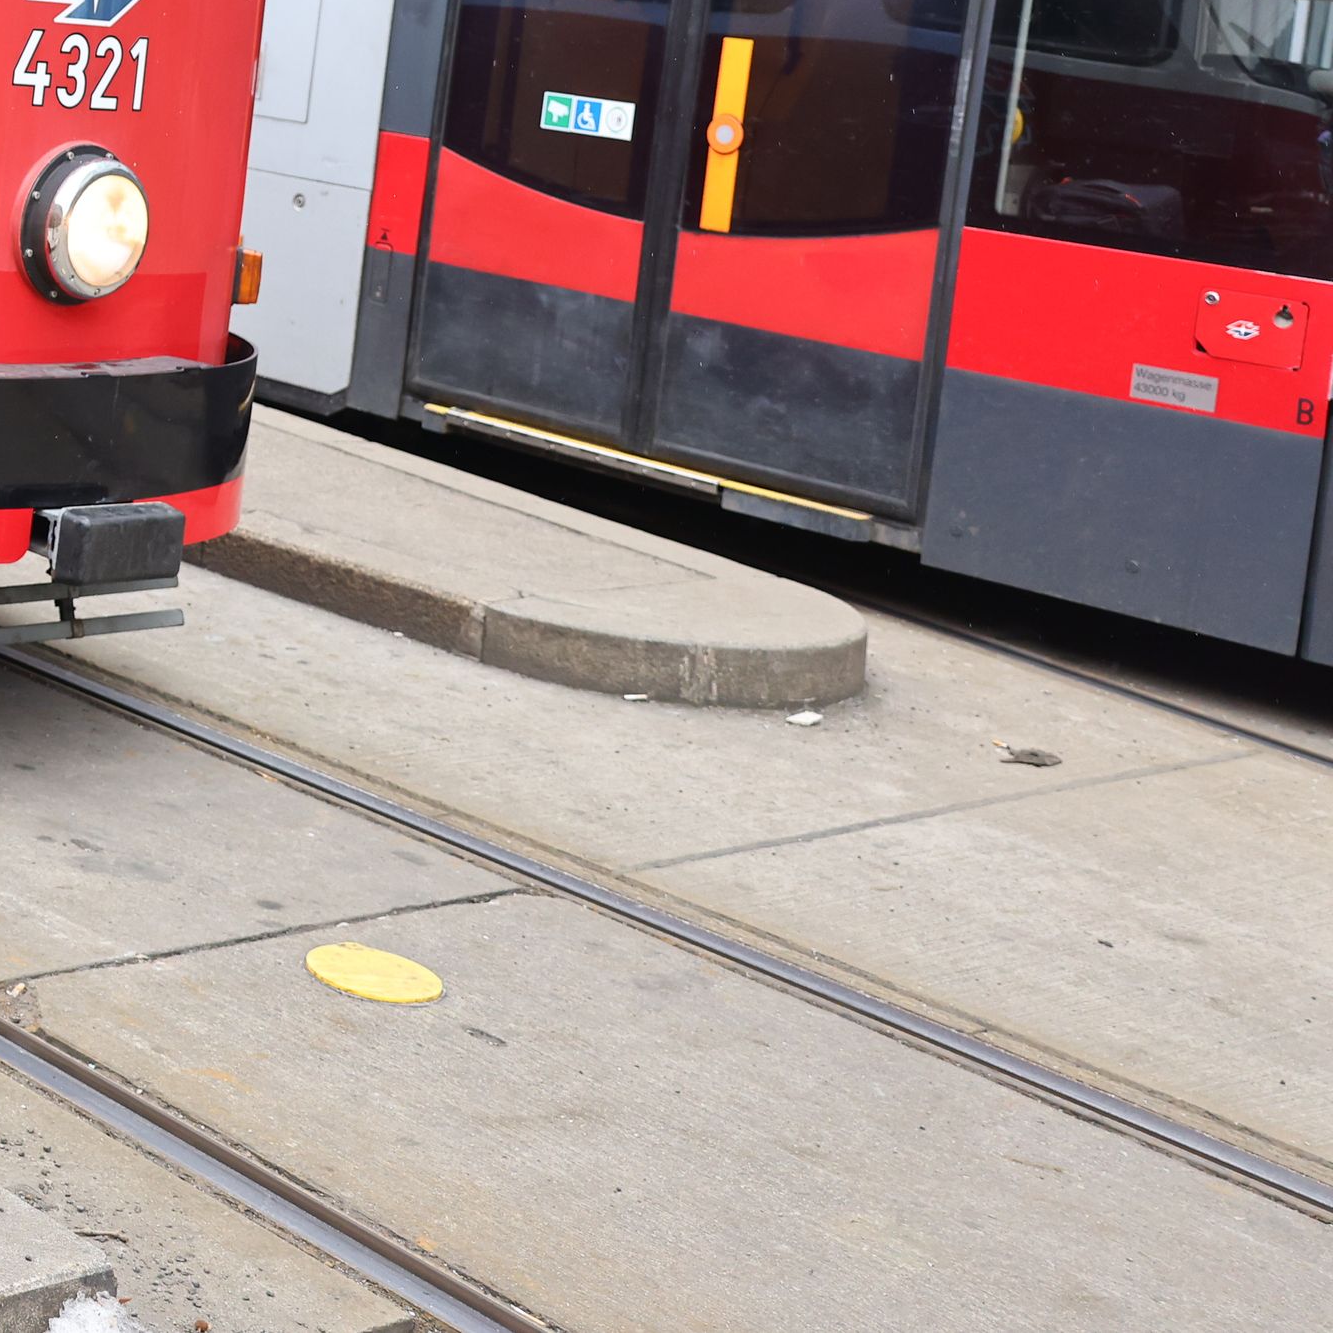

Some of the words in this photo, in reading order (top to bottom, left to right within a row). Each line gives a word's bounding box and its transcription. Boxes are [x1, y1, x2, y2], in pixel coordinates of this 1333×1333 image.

[11, 28, 149, 112] 4321
[1172, 388, 1186, 402] kg
[1296, 398, 1314, 425] B
